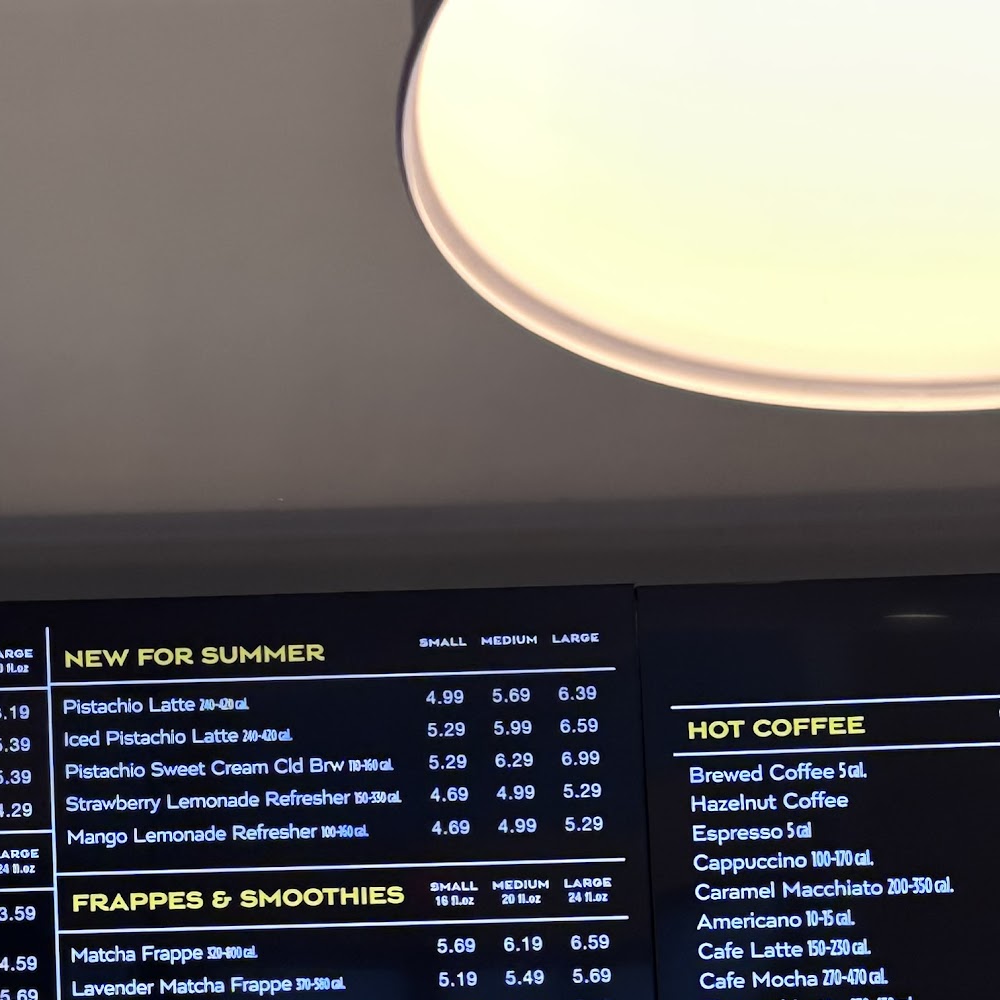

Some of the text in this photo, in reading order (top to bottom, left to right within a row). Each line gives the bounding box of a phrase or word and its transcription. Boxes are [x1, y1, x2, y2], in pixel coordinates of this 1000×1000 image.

[419, 632, 600, 648] SMALL MEDIUM LARGE
[65, 644, 325, 668] NEW FOR SUMMER
[63, 685, 597, 715] Pistachio Latte 4.99 5.69 6.39
[64, 718, 599, 748] Iced Pistachio Latte 5.29 5.99 6.59
[688, 716, 866, 740] HOT COFFEE
[65, 756, 345, 780] Pistachio Sweet Cream Cld Brw
[689, 764, 764, 784] Brewed
[769, 762, 836, 782] Coffee
[66, 788, 352, 814] Strawberry Lemonade Refresher
[691, 790, 849, 813] Hazelnut Coffee
[67, 822, 318, 848] Mango Lemonade Refresher
[692, 824, 784, 846] Espresso
[693, 852, 808, 875] Cappuccino
[72, 886, 405, 912] FRAPPES & SMOOTHIES
[694, 880, 776, 901] Caramel
[782, 879, 884, 899] Macchiato
[696, 912, 803, 931] Americano
[71, 934, 610, 965] Matcha Frappe 5.69 6.19 6.59
[698, 941, 804, 960] Cafe Latte
[72, 968, 612, 997] Lavender Matcha Frappe 5.19 5.49 5.69
[699, 969, 819, 990] Cafe Mocha
